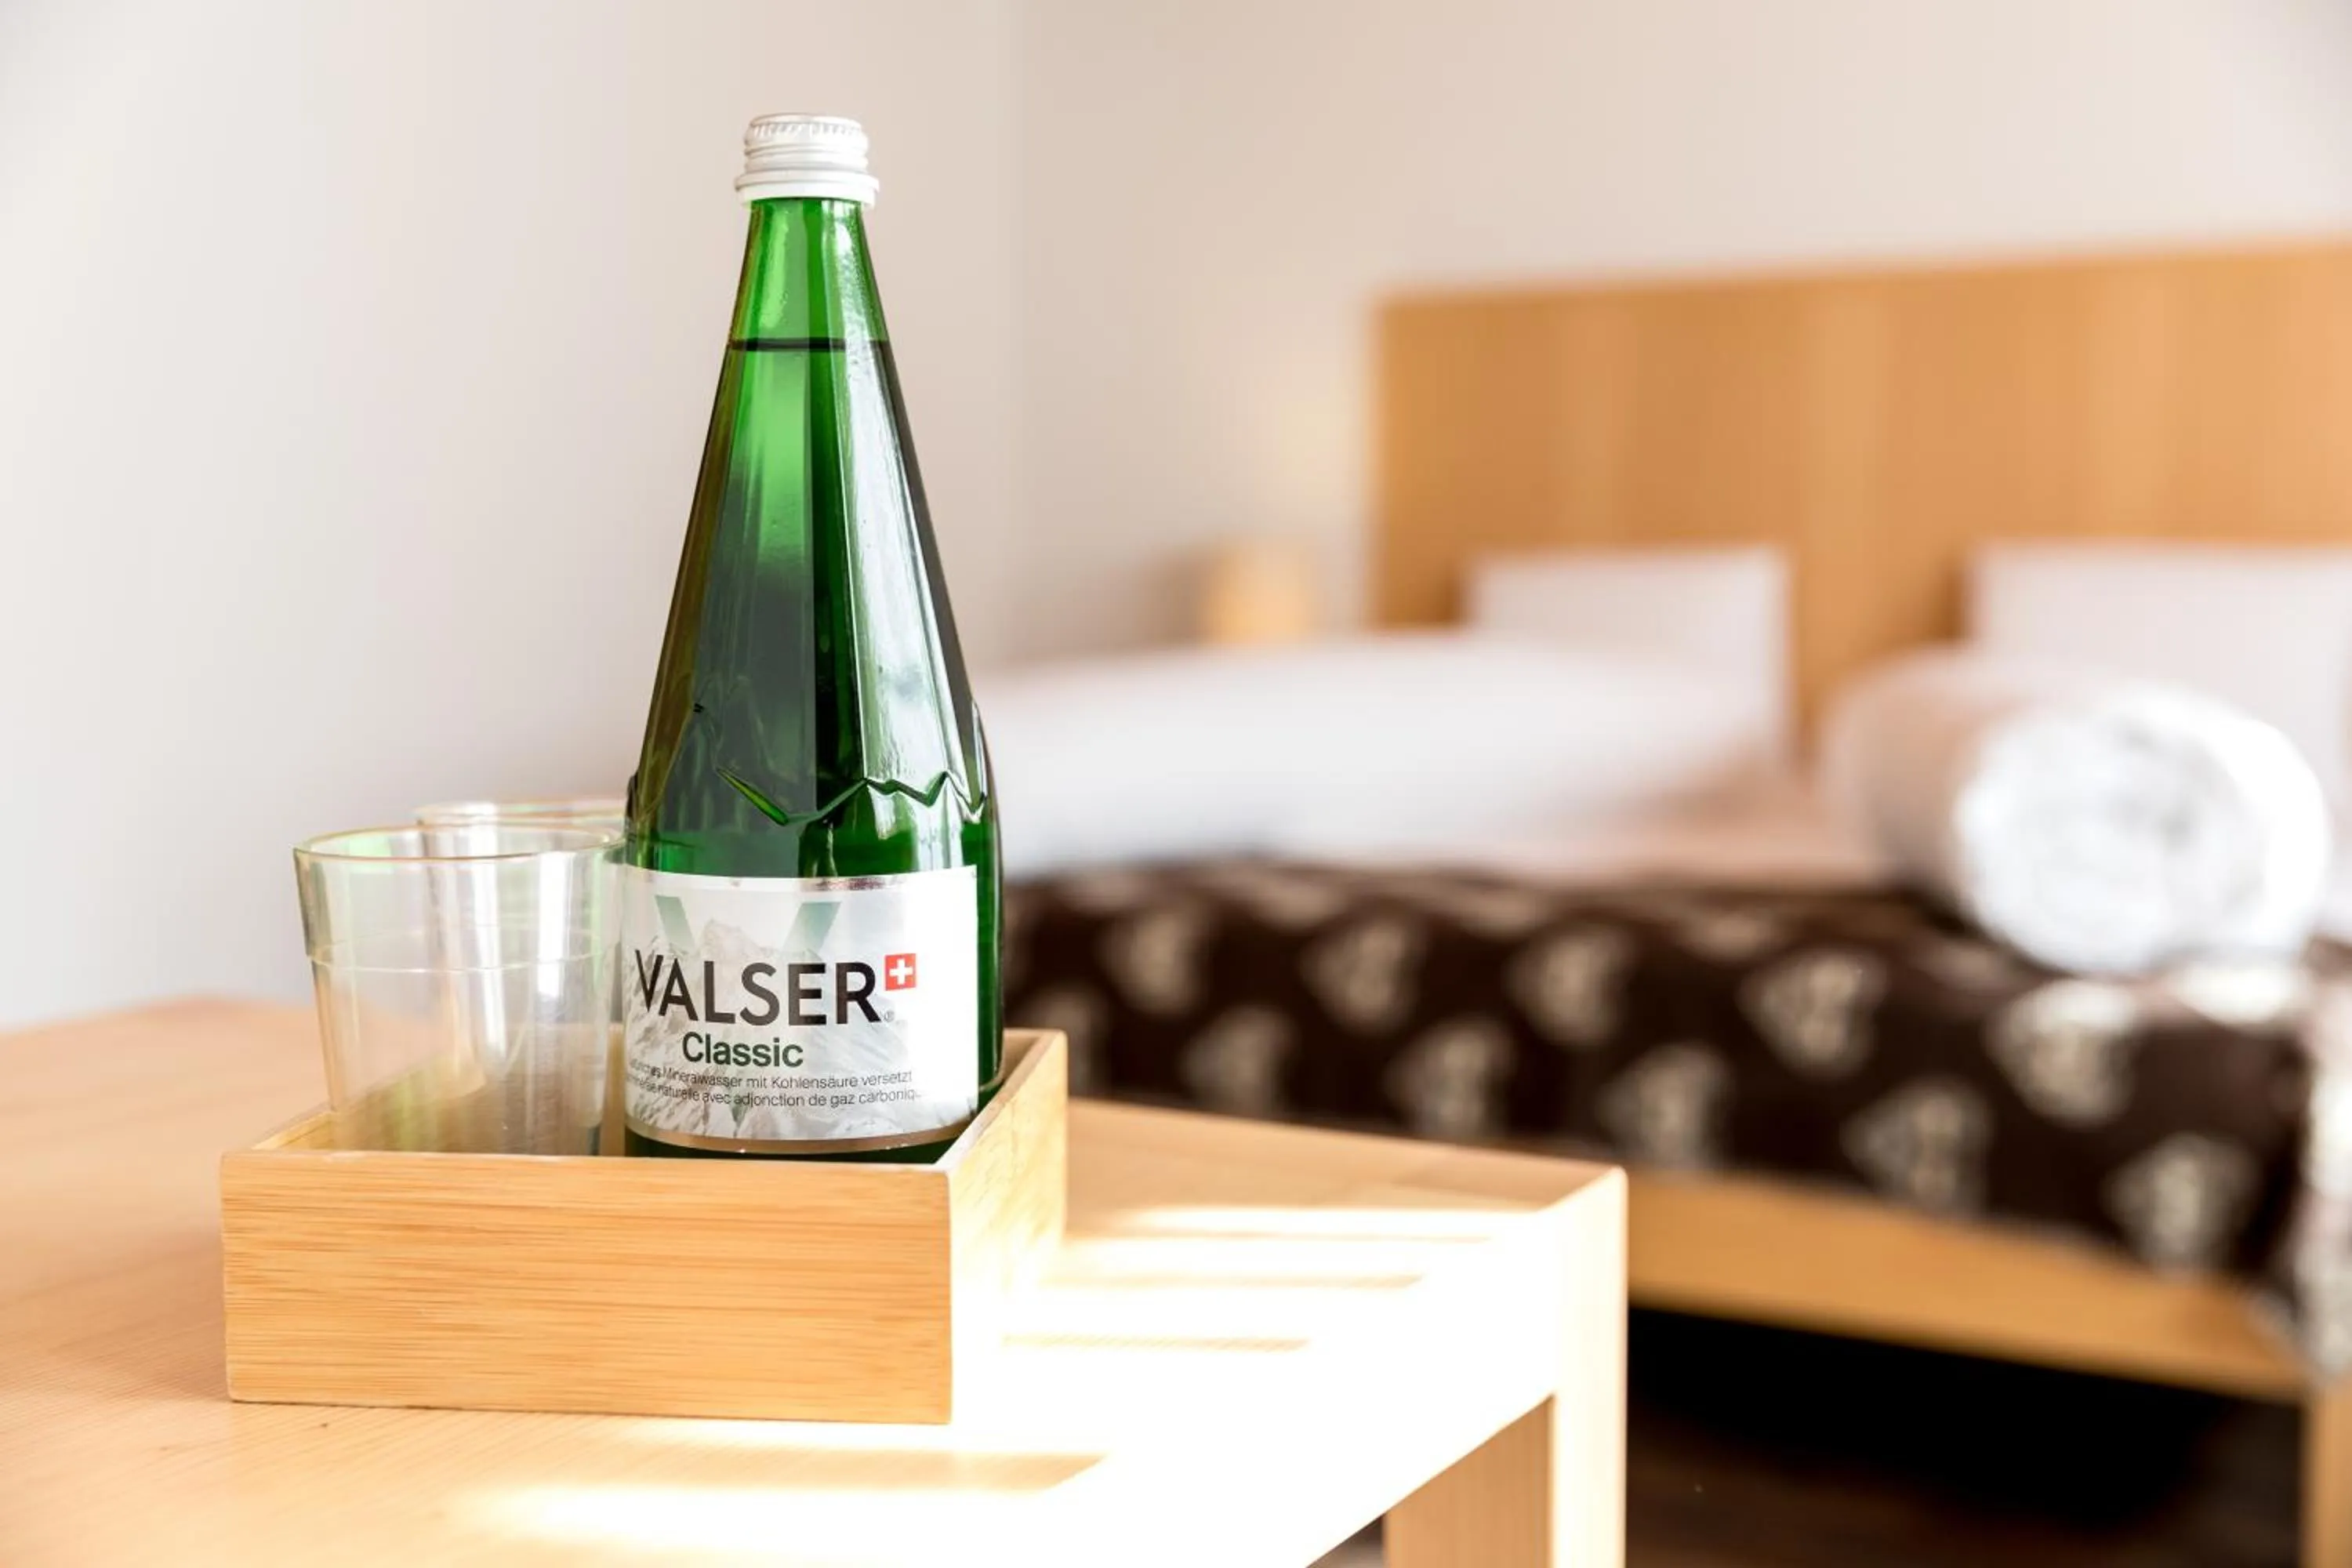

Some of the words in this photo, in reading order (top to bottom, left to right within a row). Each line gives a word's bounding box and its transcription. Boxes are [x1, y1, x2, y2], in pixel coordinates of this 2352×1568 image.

[635, 949, 881, 1025] VALSER
[682, 1032, 804, 1066] Classic
[746, 1076, 768, 1089] mit
[772, 1073, 858, 1089] Kohlensäure
[862, 1070, 912, 1086] versetzt
[702, 1093, 731, 1104] avec
[733, 1092, 804, 1109] adjonction
[808, 1093, 827, 1106] de
[830, 1094, 855, 1108] gaz
[858, 1087, 922, 1102] carboniq
